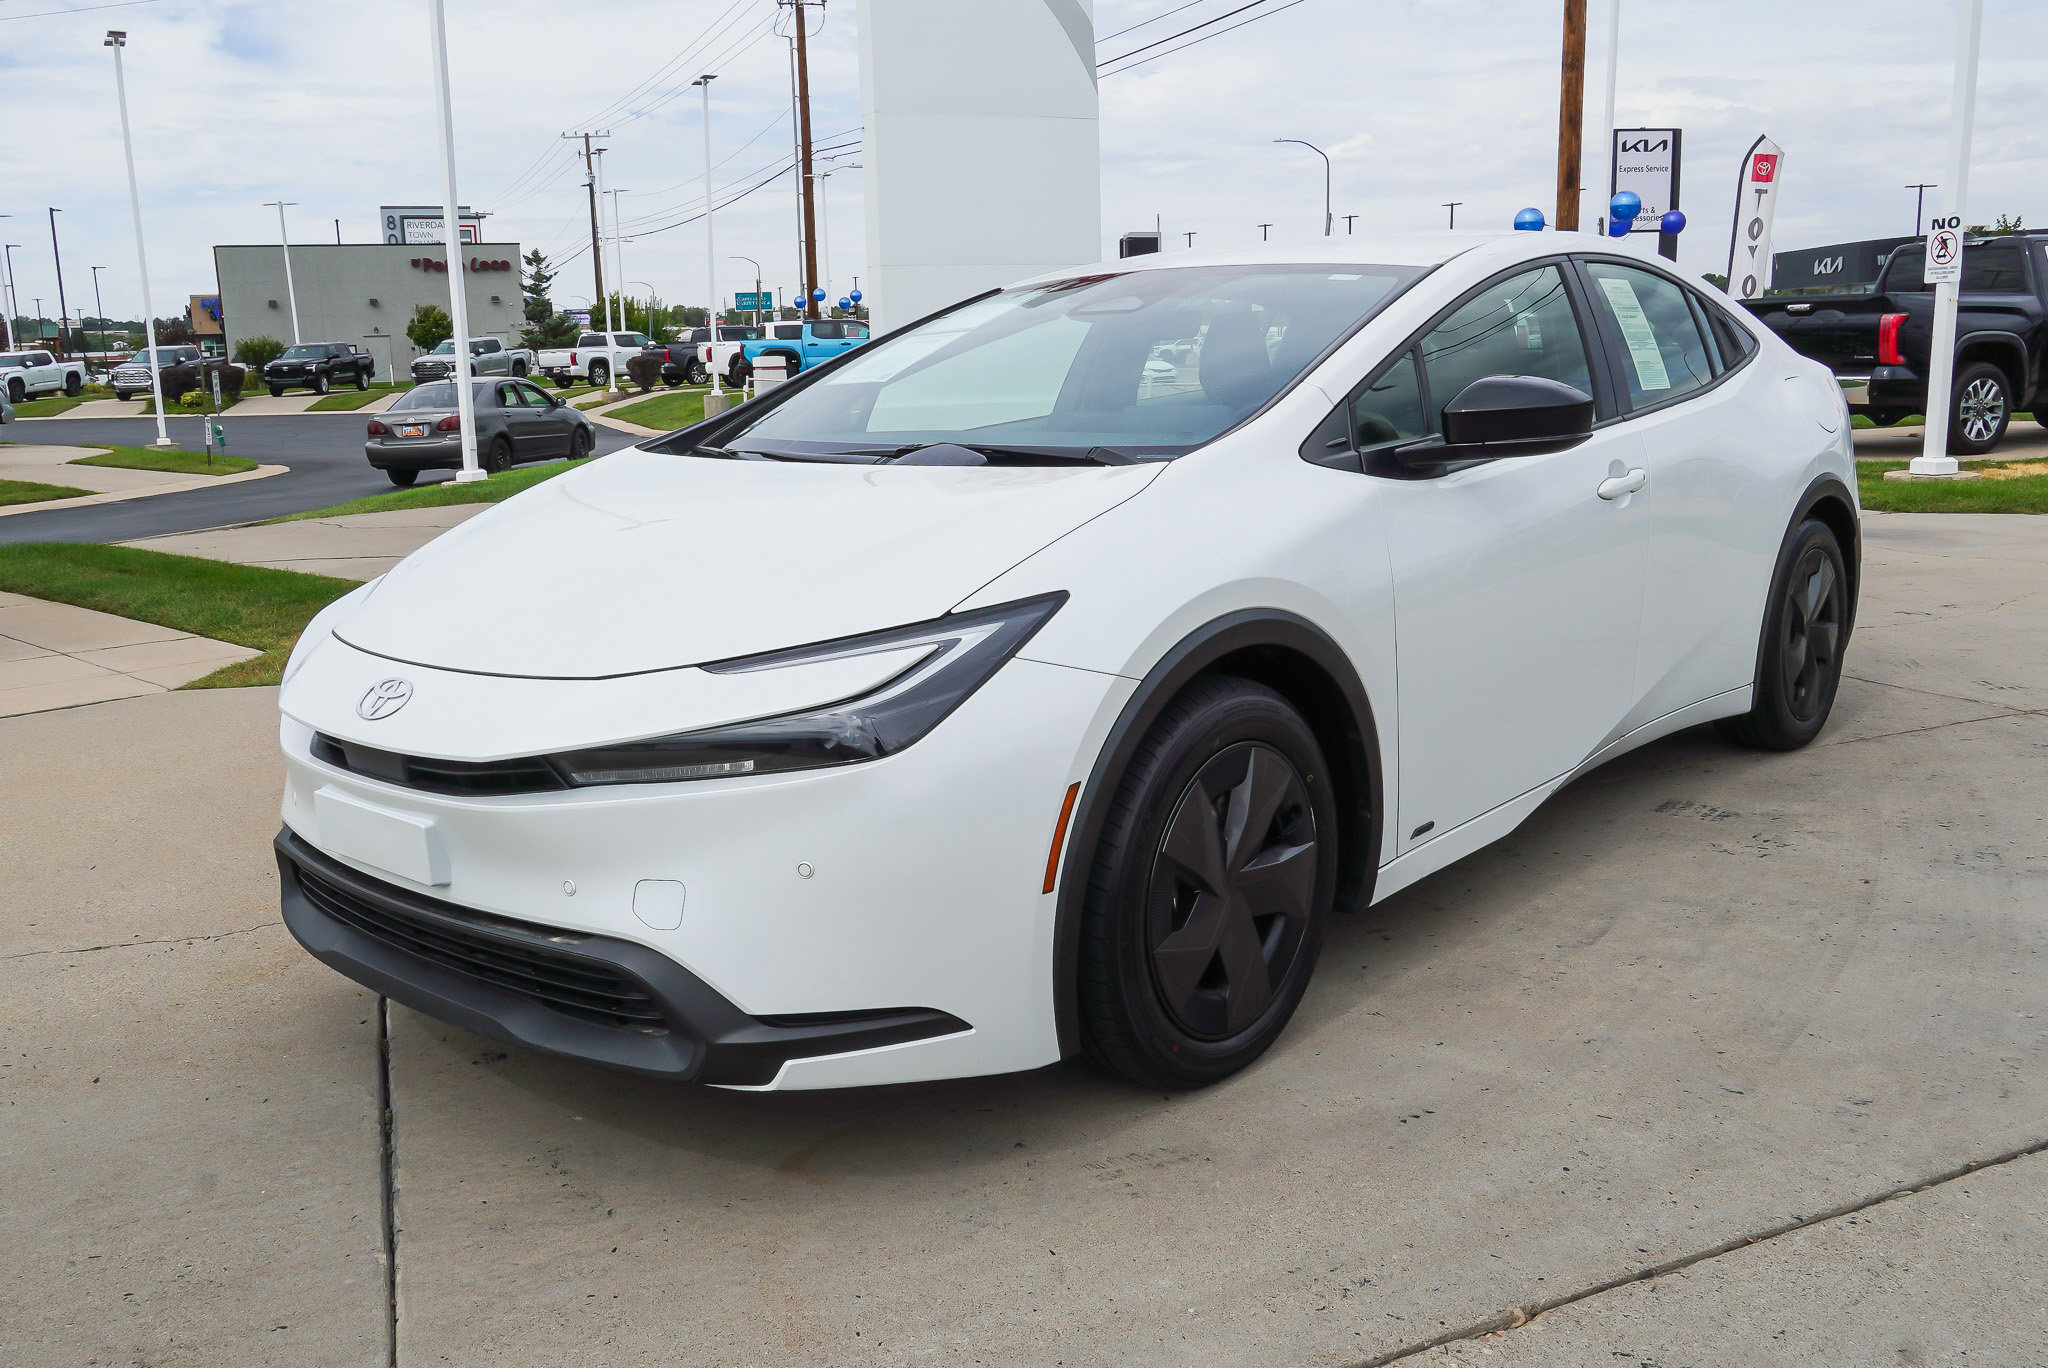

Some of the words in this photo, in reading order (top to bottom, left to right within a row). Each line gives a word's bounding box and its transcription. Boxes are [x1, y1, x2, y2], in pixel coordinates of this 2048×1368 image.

[1621, 139, 1668, 152] KIA
[1619, 165, 1644, 174] Express
[1645, 165, 1669, 173] Service
[406, 221, 445, 229] RIVERDA
[1931, 216, 1961, 231] NO
[1742, 189, 1768, 299] TOYO
[470, 257, 511, 272] Loco
[1813, 256, 1844, 275] KIA
